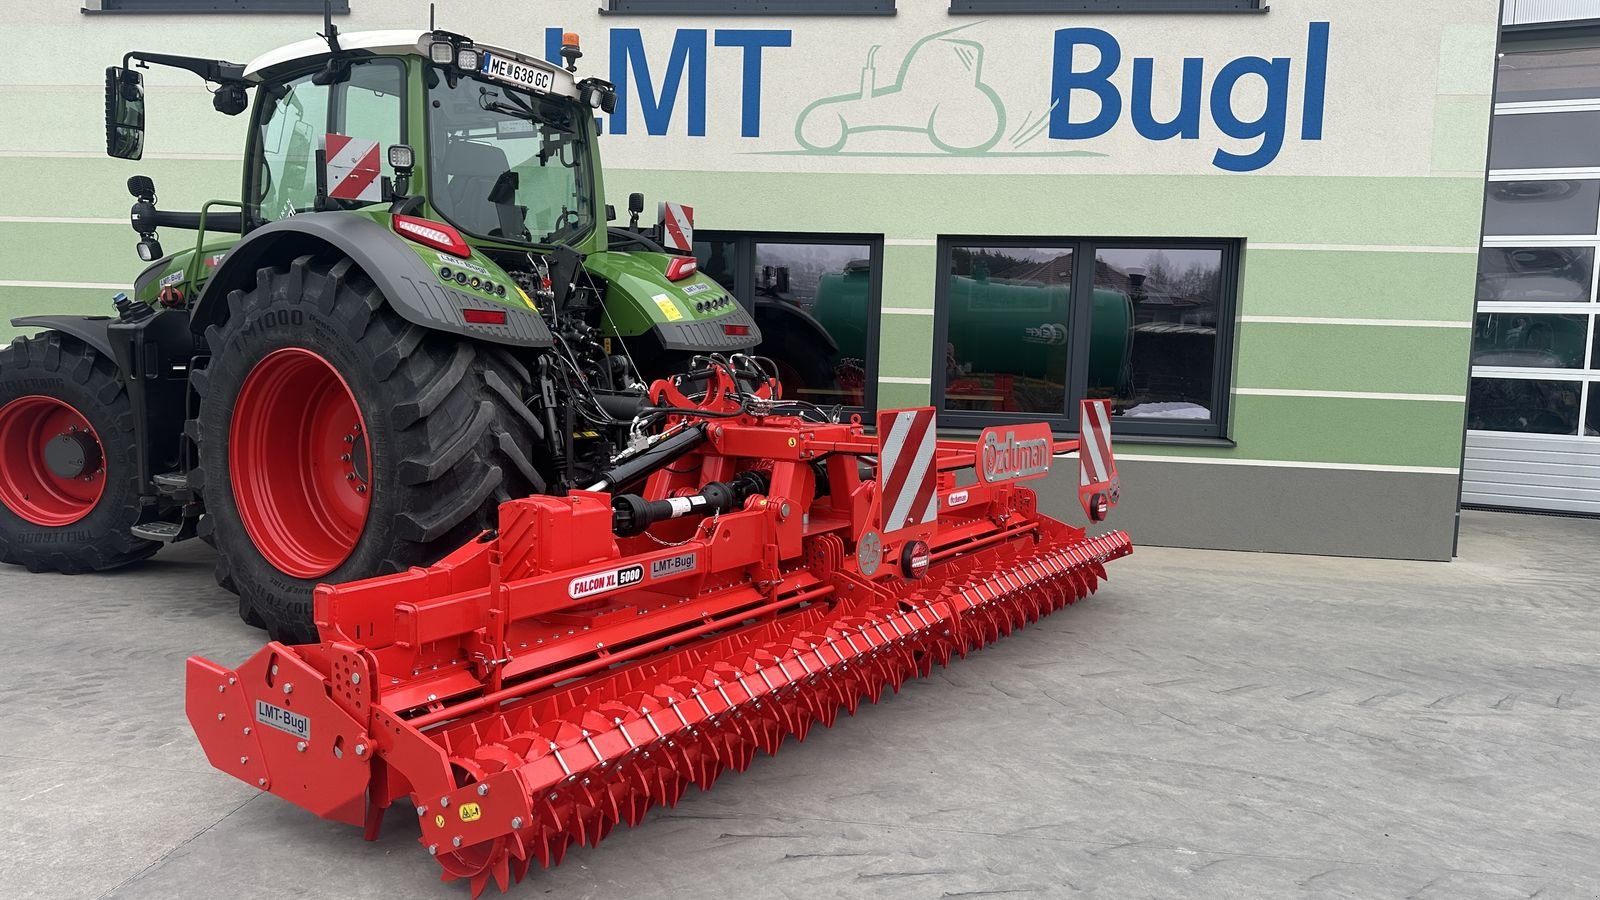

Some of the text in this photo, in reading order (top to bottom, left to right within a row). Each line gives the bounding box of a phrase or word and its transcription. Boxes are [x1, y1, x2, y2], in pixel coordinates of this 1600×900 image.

[491, 59, 507, 76] ME
[513, 66, 534, 84] 638
[535, 72, 549, 88] GC
[1049, 21, 1330, 171] Bugl
[653, 554, 694, 573] LMT-Bugl
[573, 577, 605, 595] FALCON
[606, 575, 616, 587] XL
[620, 568, 640, 583] 5000
[259, 702, 307, 733] LMT-Bugl
